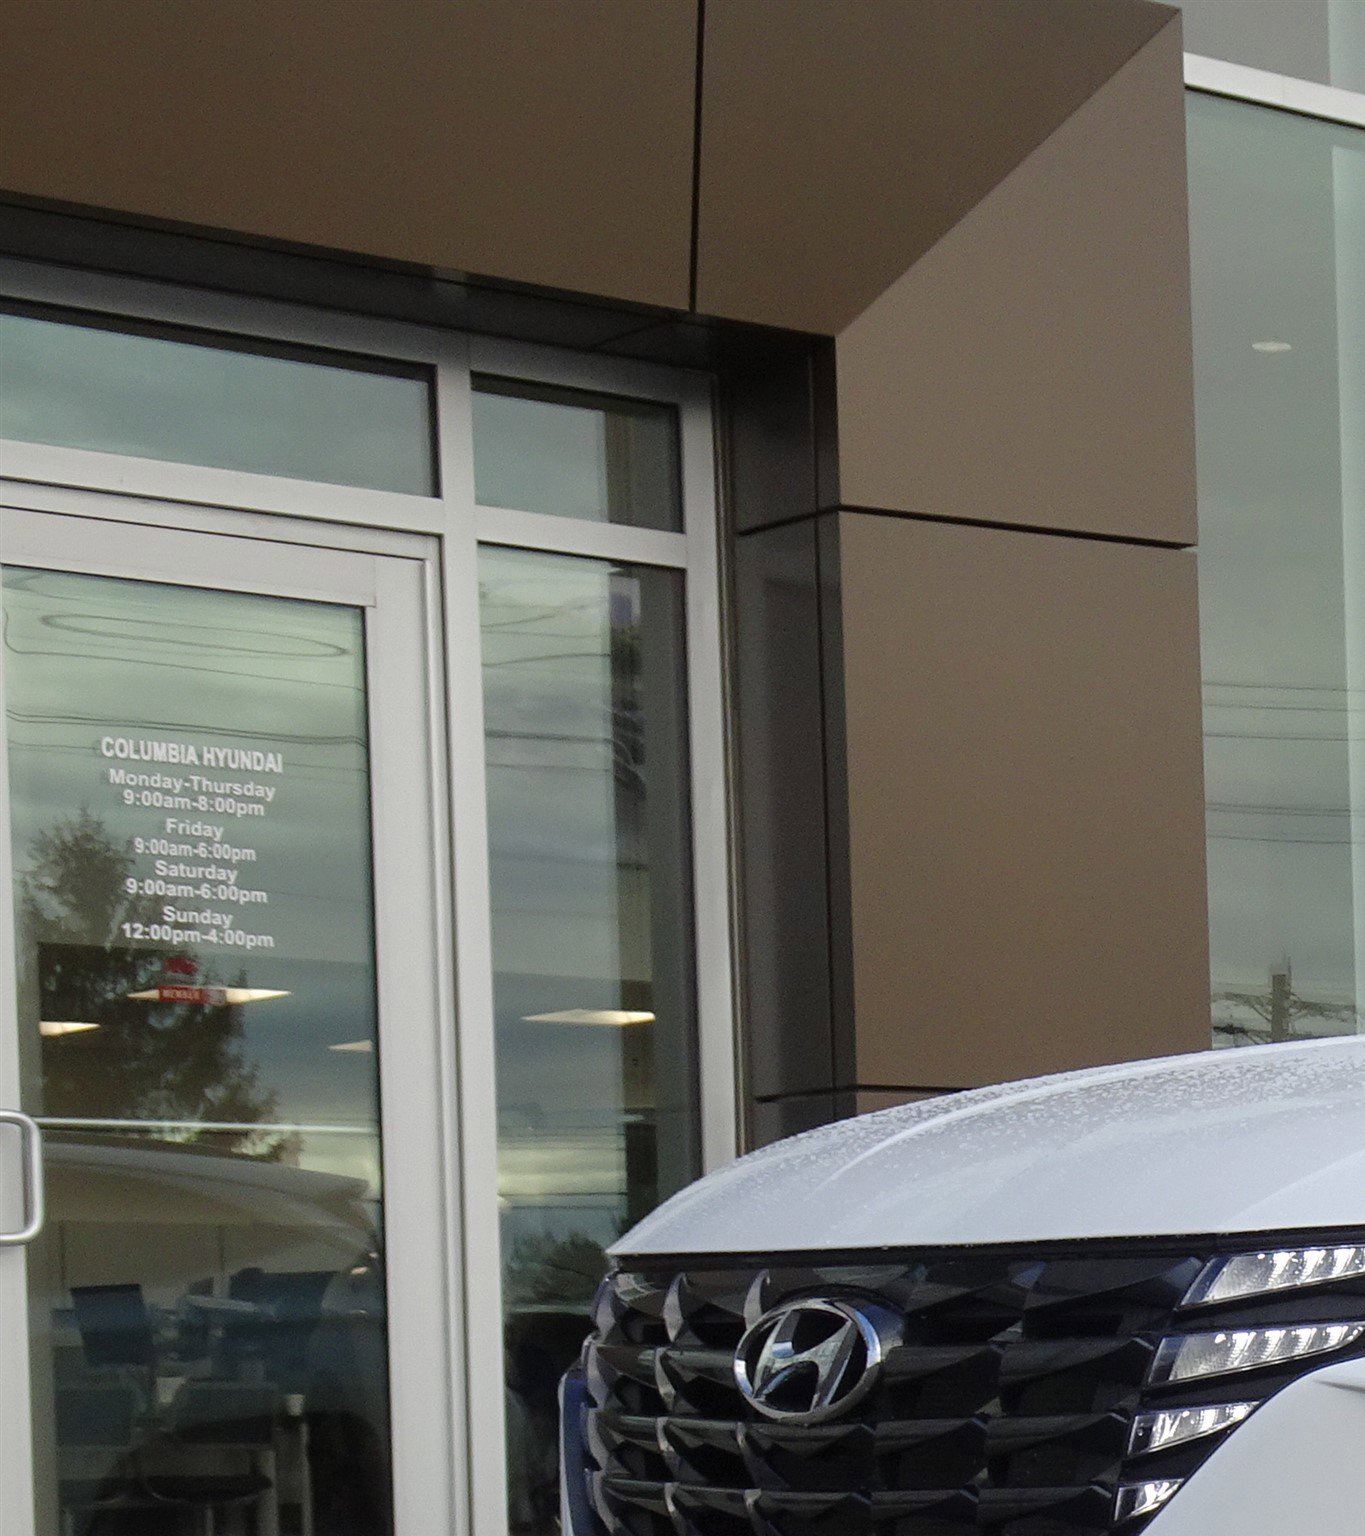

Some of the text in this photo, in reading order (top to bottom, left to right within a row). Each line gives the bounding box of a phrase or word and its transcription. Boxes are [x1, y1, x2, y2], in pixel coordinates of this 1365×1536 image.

[101, 736, 284, 773] COLUMBIA HYUNDAI
[109, 768, 276, 801] Monday-Thursday
[122, 789, 265, 817] 9:00am-8:00pm
[165, 818, 224, 841] Friday
[134, 837, 256, 863] 9:00am-6:00pm
[155, 860, 237, 884] Saturday
[125, 877, 268, 905] 9:00am-6:00pm
[162, 905, 233, 928] Sunday
[121, 922, 275, 950] 12:00pm-4:00pm
